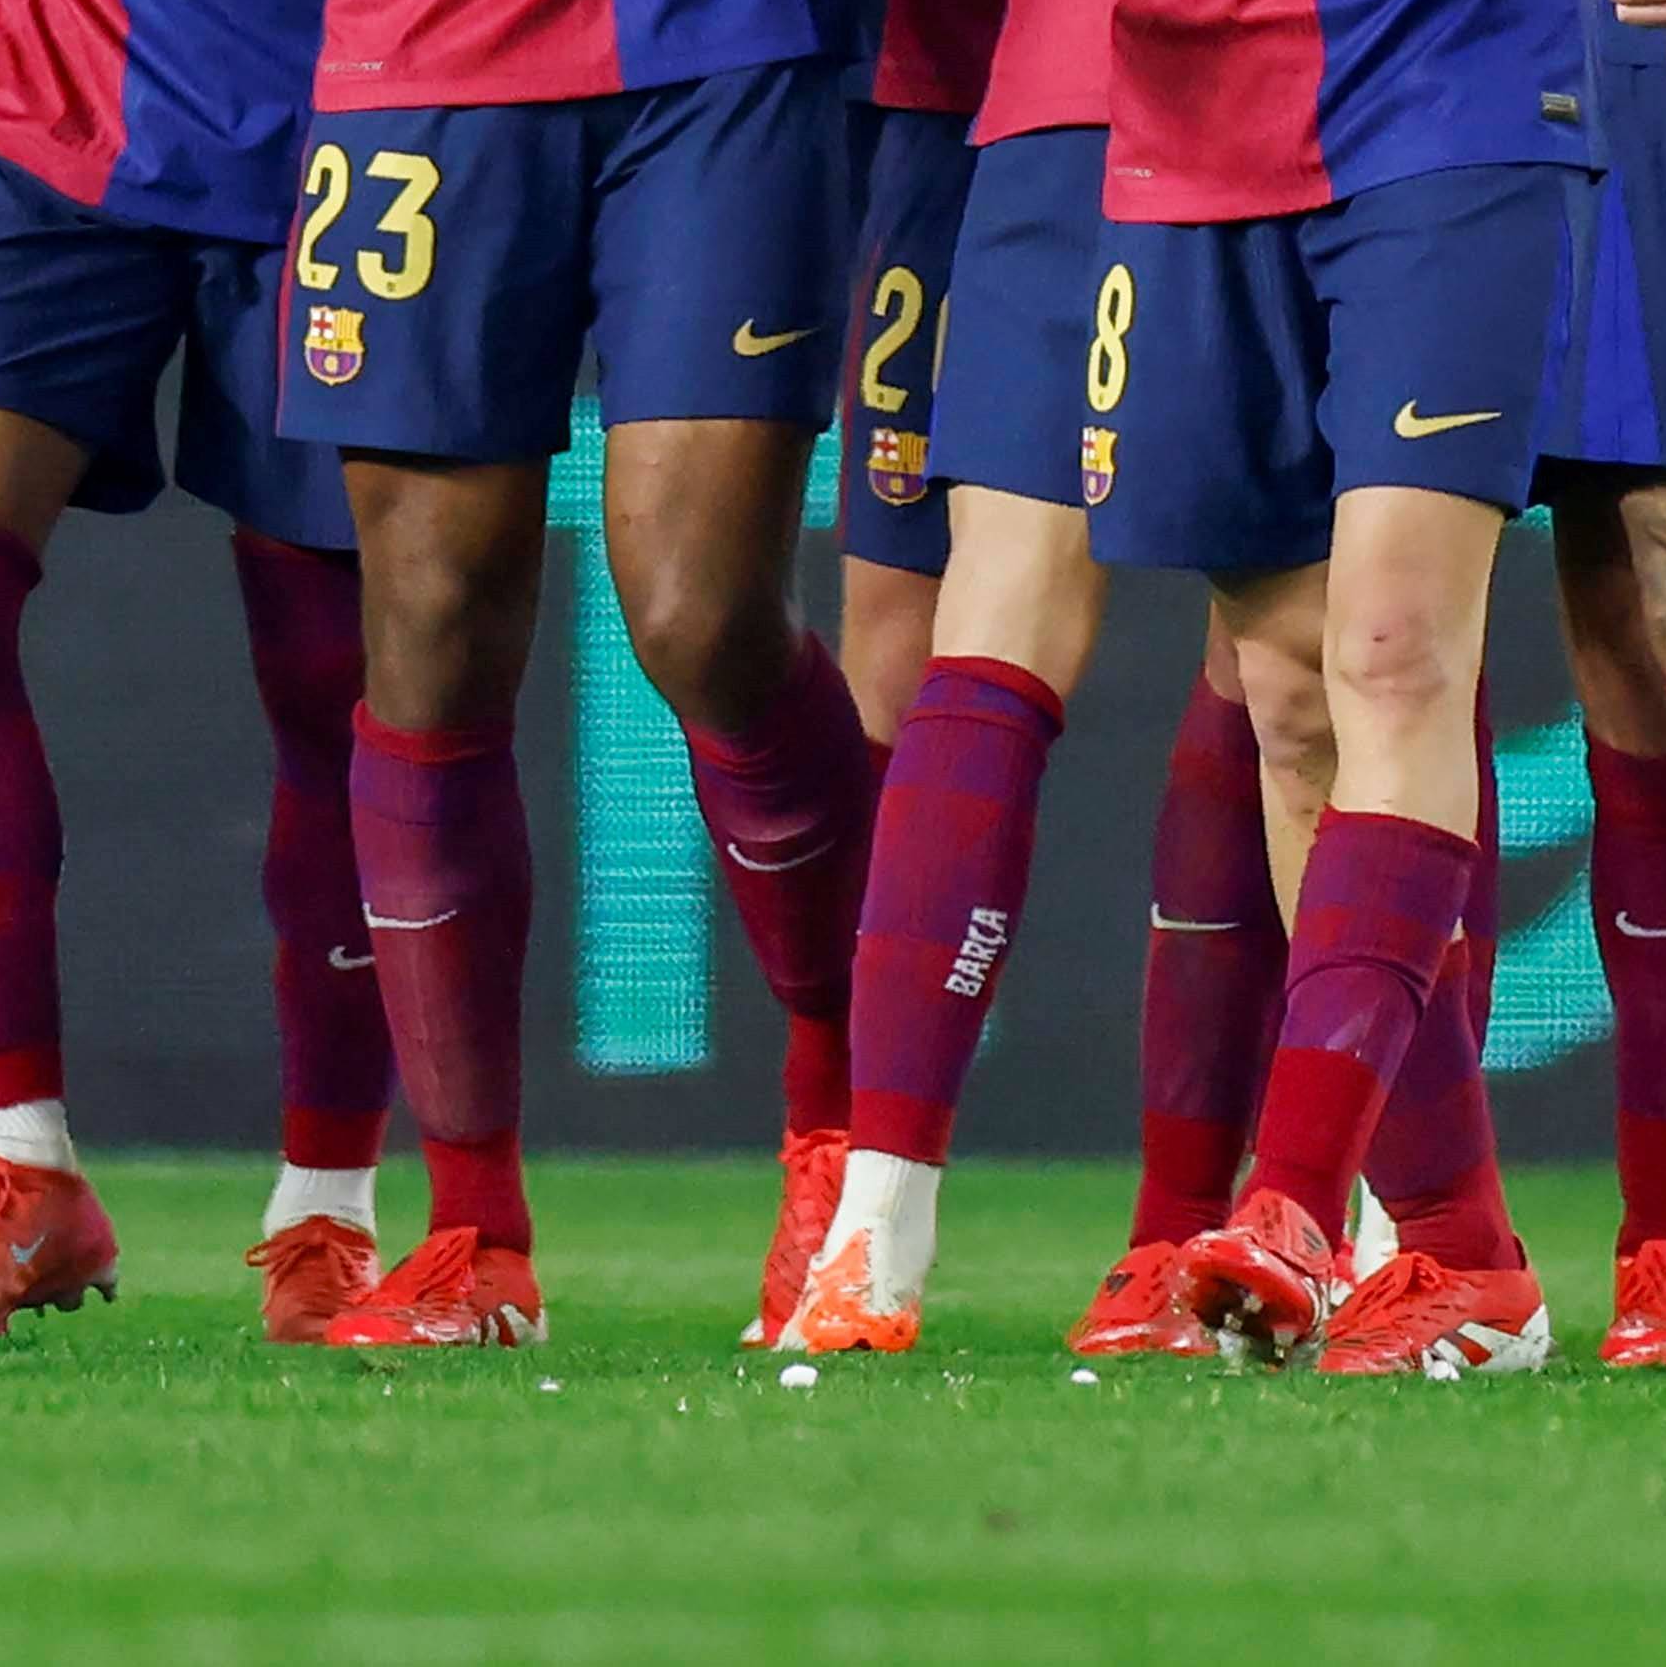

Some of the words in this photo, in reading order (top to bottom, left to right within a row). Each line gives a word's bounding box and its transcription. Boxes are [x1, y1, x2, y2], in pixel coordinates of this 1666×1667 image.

[296, 143, 442, 300] 23
[860, 265, 950, 414] 2
[1087, 263, 1133, 413] 8
[944, 907, 1008, 998] BARÇA
